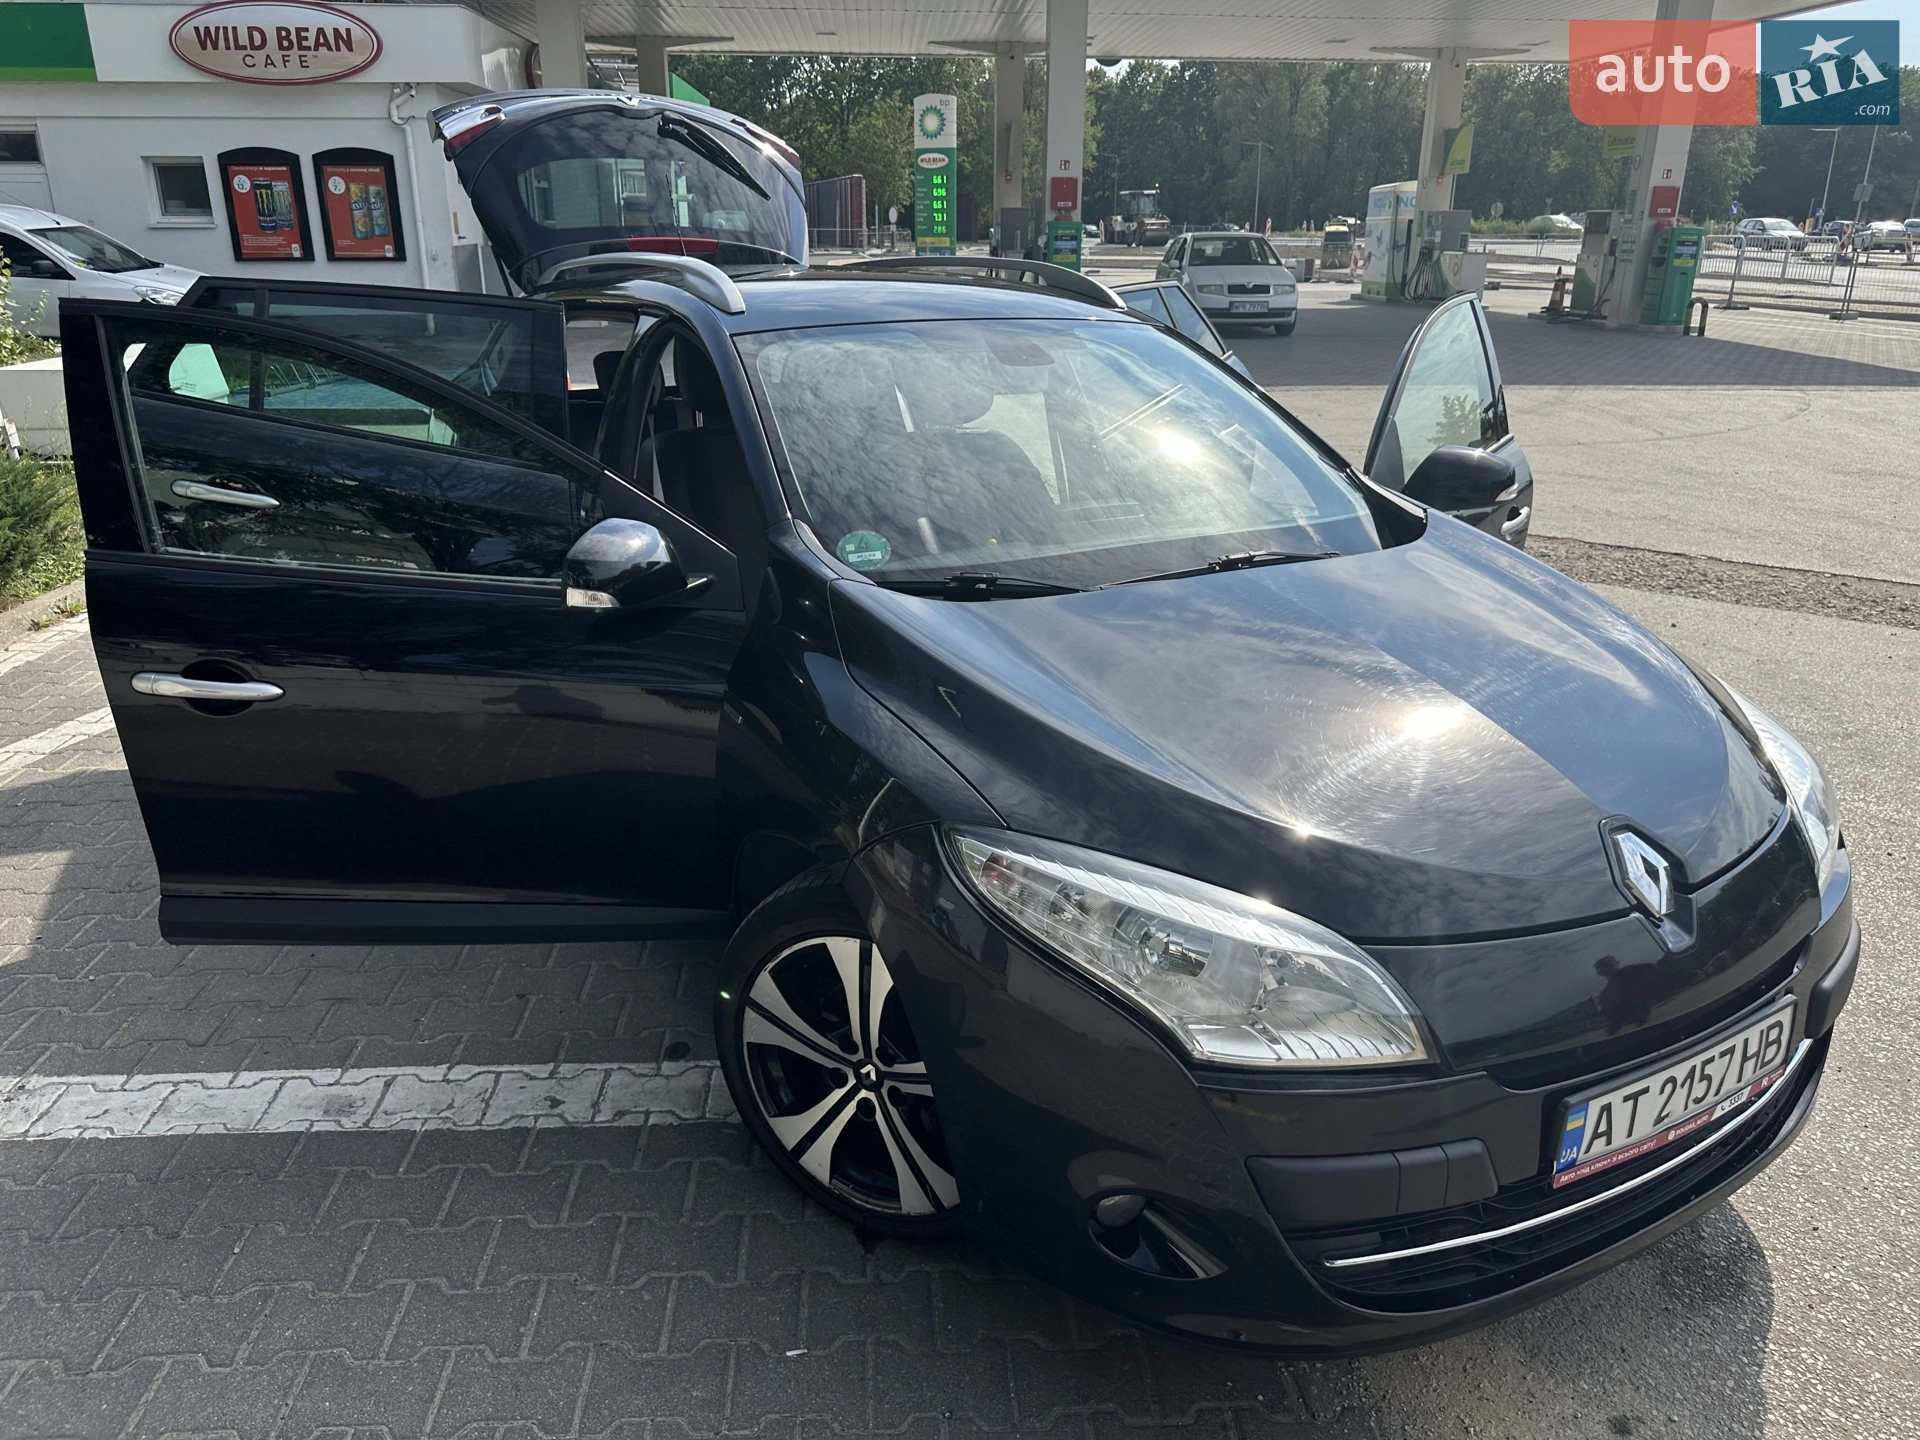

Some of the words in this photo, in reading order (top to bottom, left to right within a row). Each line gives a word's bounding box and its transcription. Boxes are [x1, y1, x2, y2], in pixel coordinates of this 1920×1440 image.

[193, 26, 268, 51] WILD
[276, 26, 354, 53] BEAN
[242, 53, 311, 69] CAFE
[939, 98, 950, 108] bp
[1560, 1145, 1578, 1163] UA
[1559, 1172, 1576, 1183] Авто
[1618, 1145, 1639, 1160] всього
